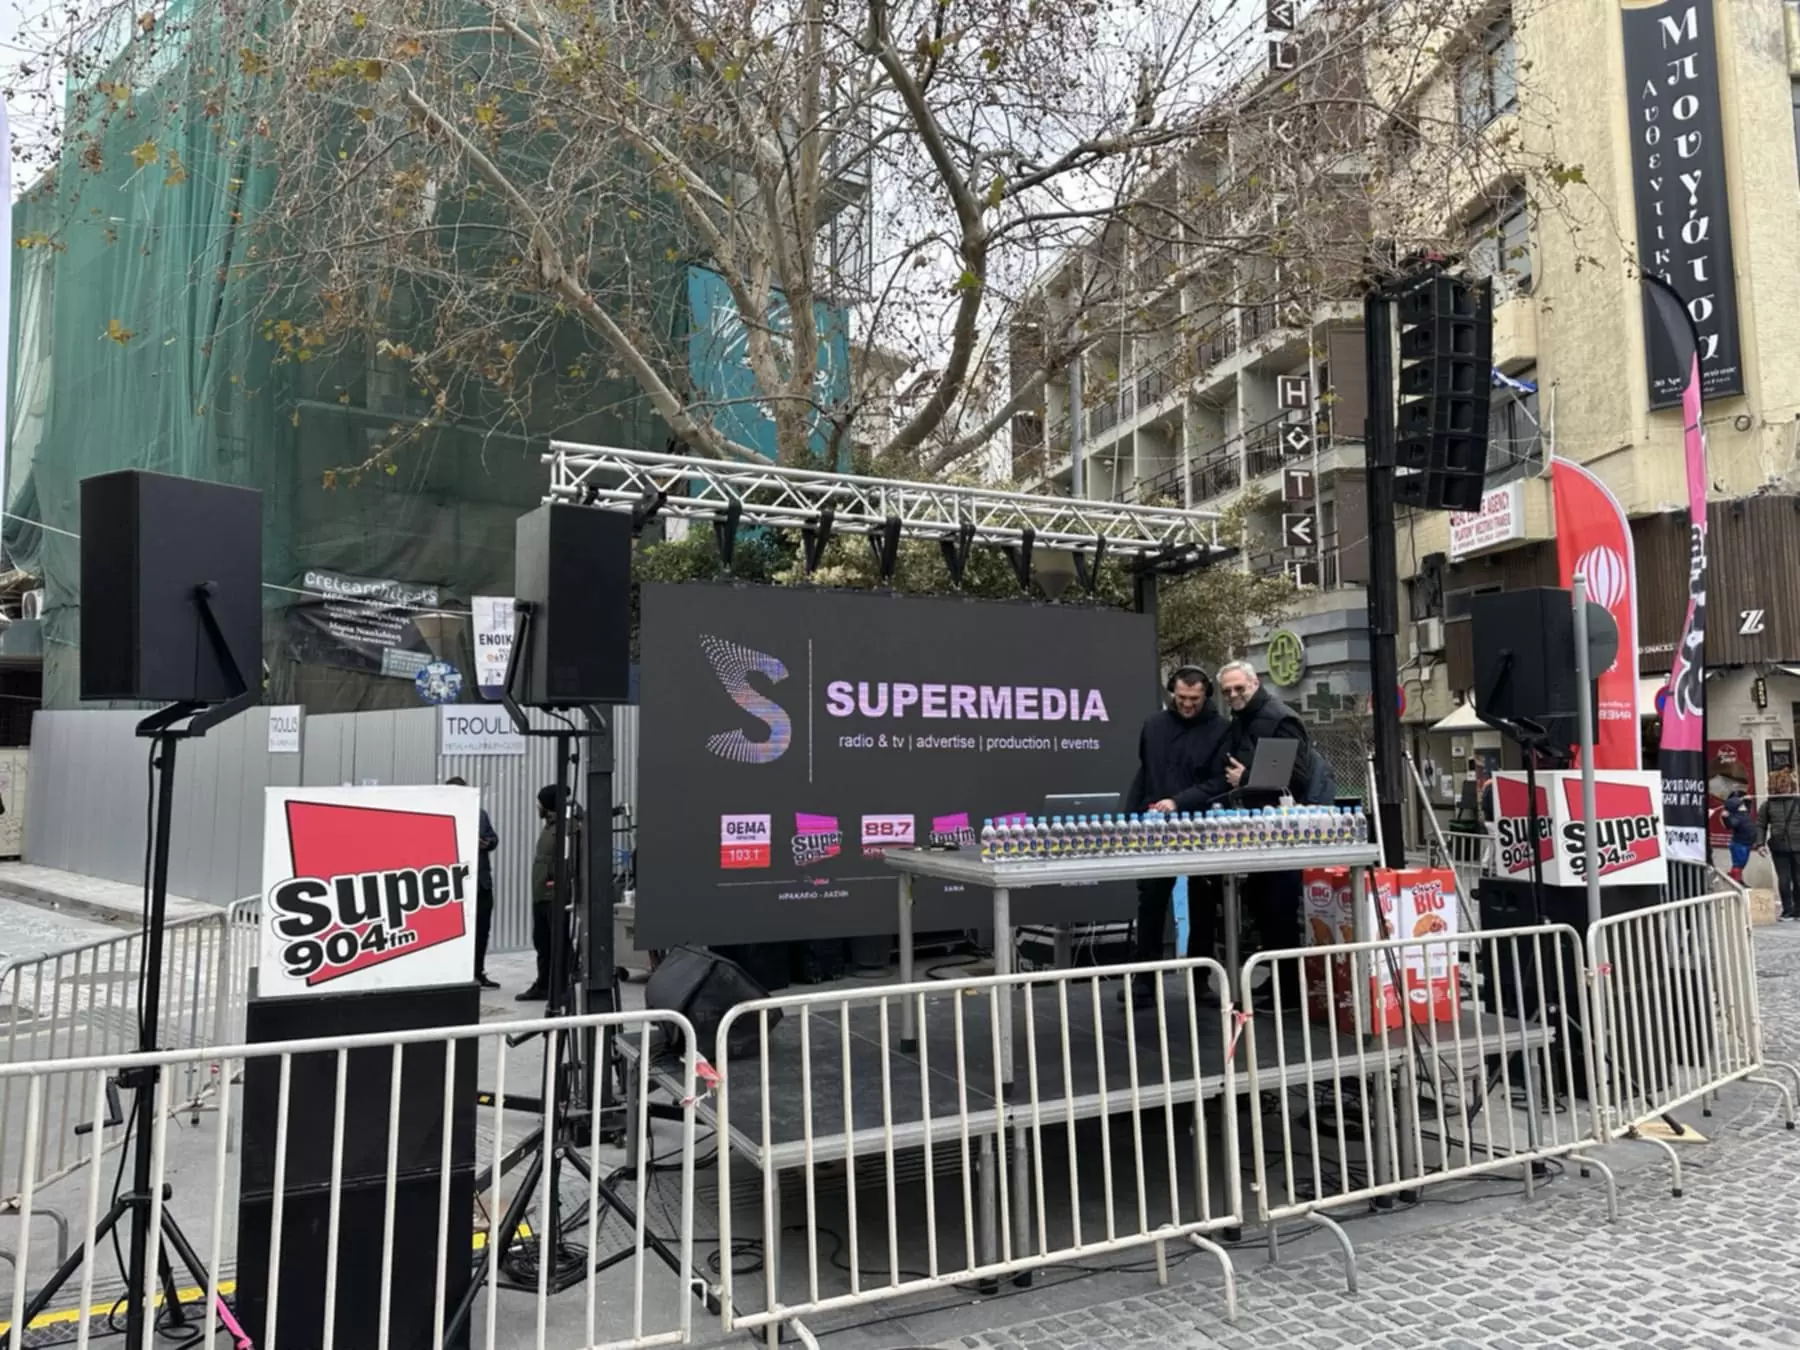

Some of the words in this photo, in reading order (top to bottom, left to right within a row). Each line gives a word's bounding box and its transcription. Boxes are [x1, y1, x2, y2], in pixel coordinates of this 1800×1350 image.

[826, 680, 1110, 722] SUPERMEDIA
[839, 734, 874, 748] radio
[878, 735, 888, 748] &
[892, 736, 905, 748] tv
[916, 735, 976, 749] advertise
[986, 736, 1051, 752] production
[1061, 738, 1100, 750] events
[1498, 816, 1553, 847] Suer
[1563, 816, 1660, 854] Super
[276, 864, 470, 937] Super
[1413, 890, 1445, 915] BIG
